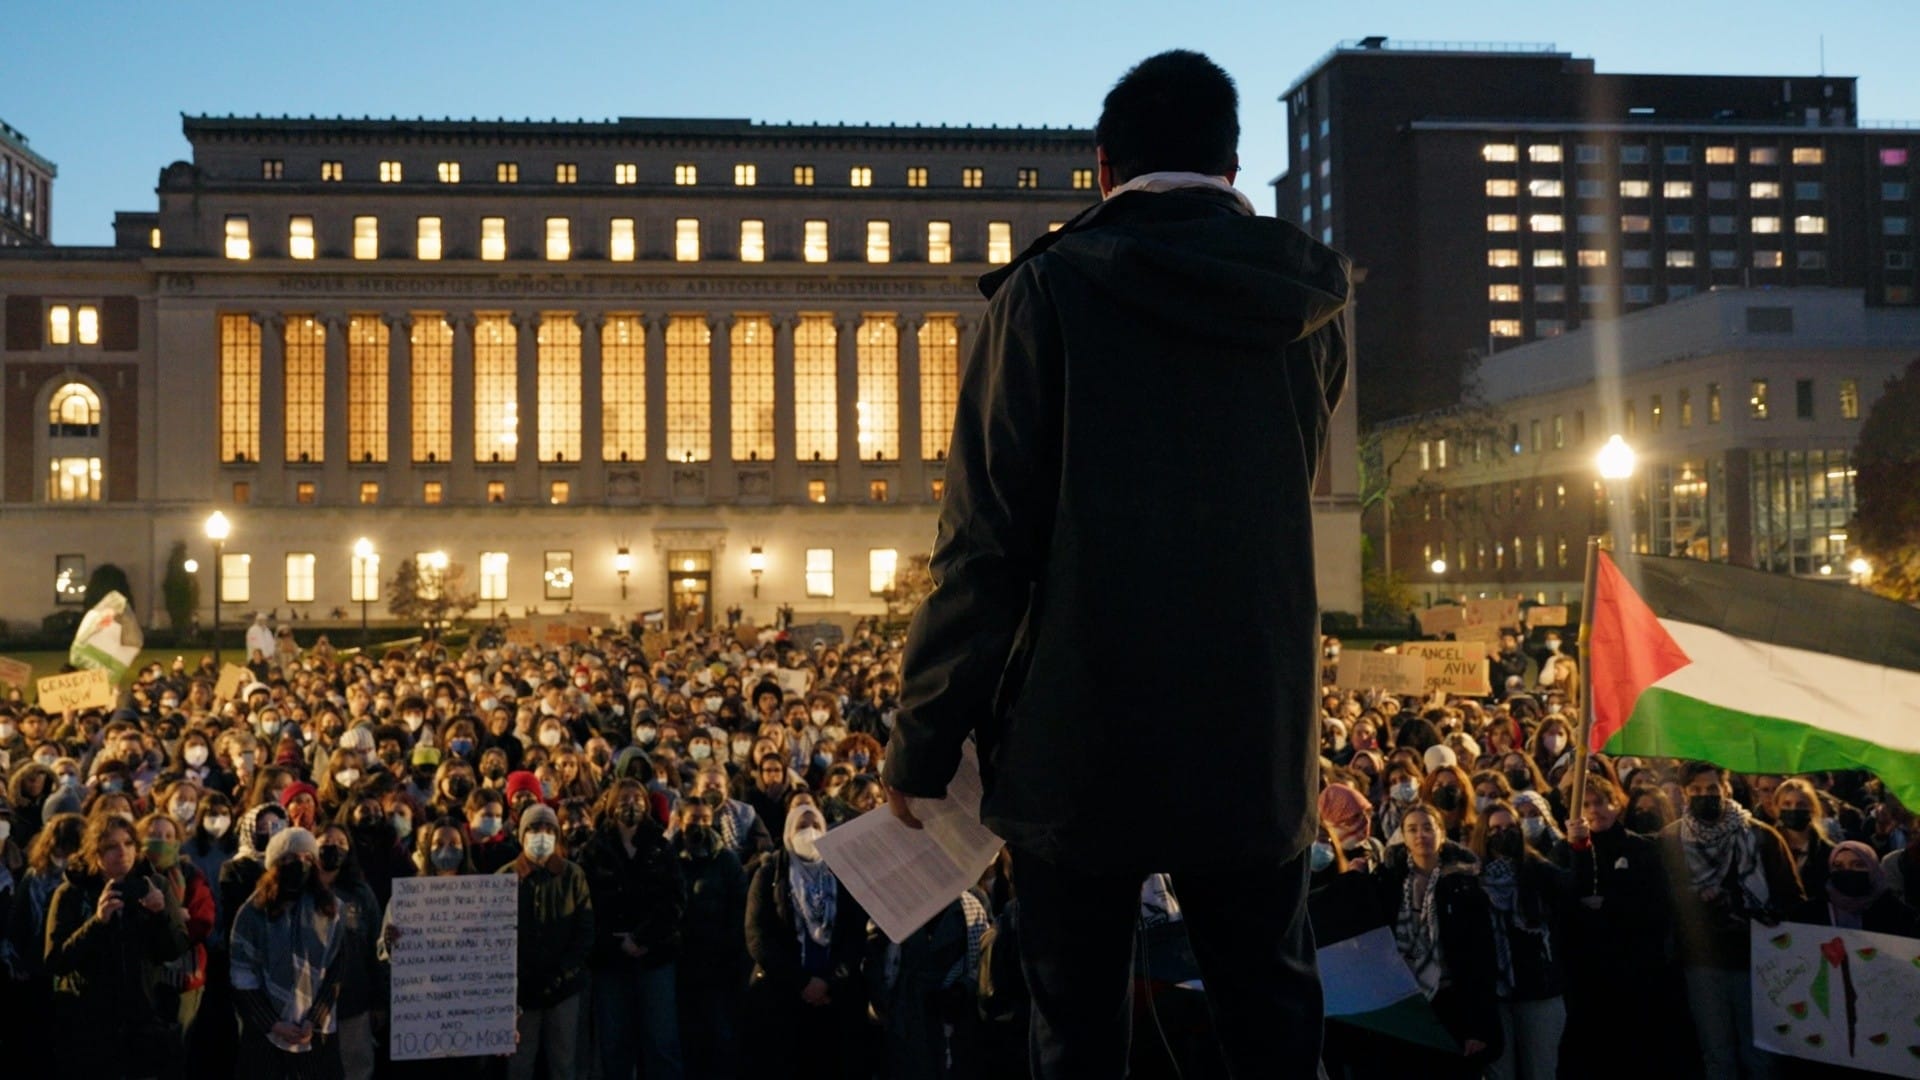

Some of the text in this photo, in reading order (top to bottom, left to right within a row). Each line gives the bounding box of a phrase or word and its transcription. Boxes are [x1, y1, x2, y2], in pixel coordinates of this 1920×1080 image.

[279, 278, 346, 292] HOMER
[358, 278, 473, 292] HERODOTUS
[487, 278, 594, 293] SOPHOCLES
[610, 279, 670, 293] PLATO
[686, 279, 785, 293] ARISTOTLE
[797, 280, 927, 294] DEMOSTHENES
[1443, 662, 1477, 675] AVIV
[440, 1021, 464, 1030] AND
